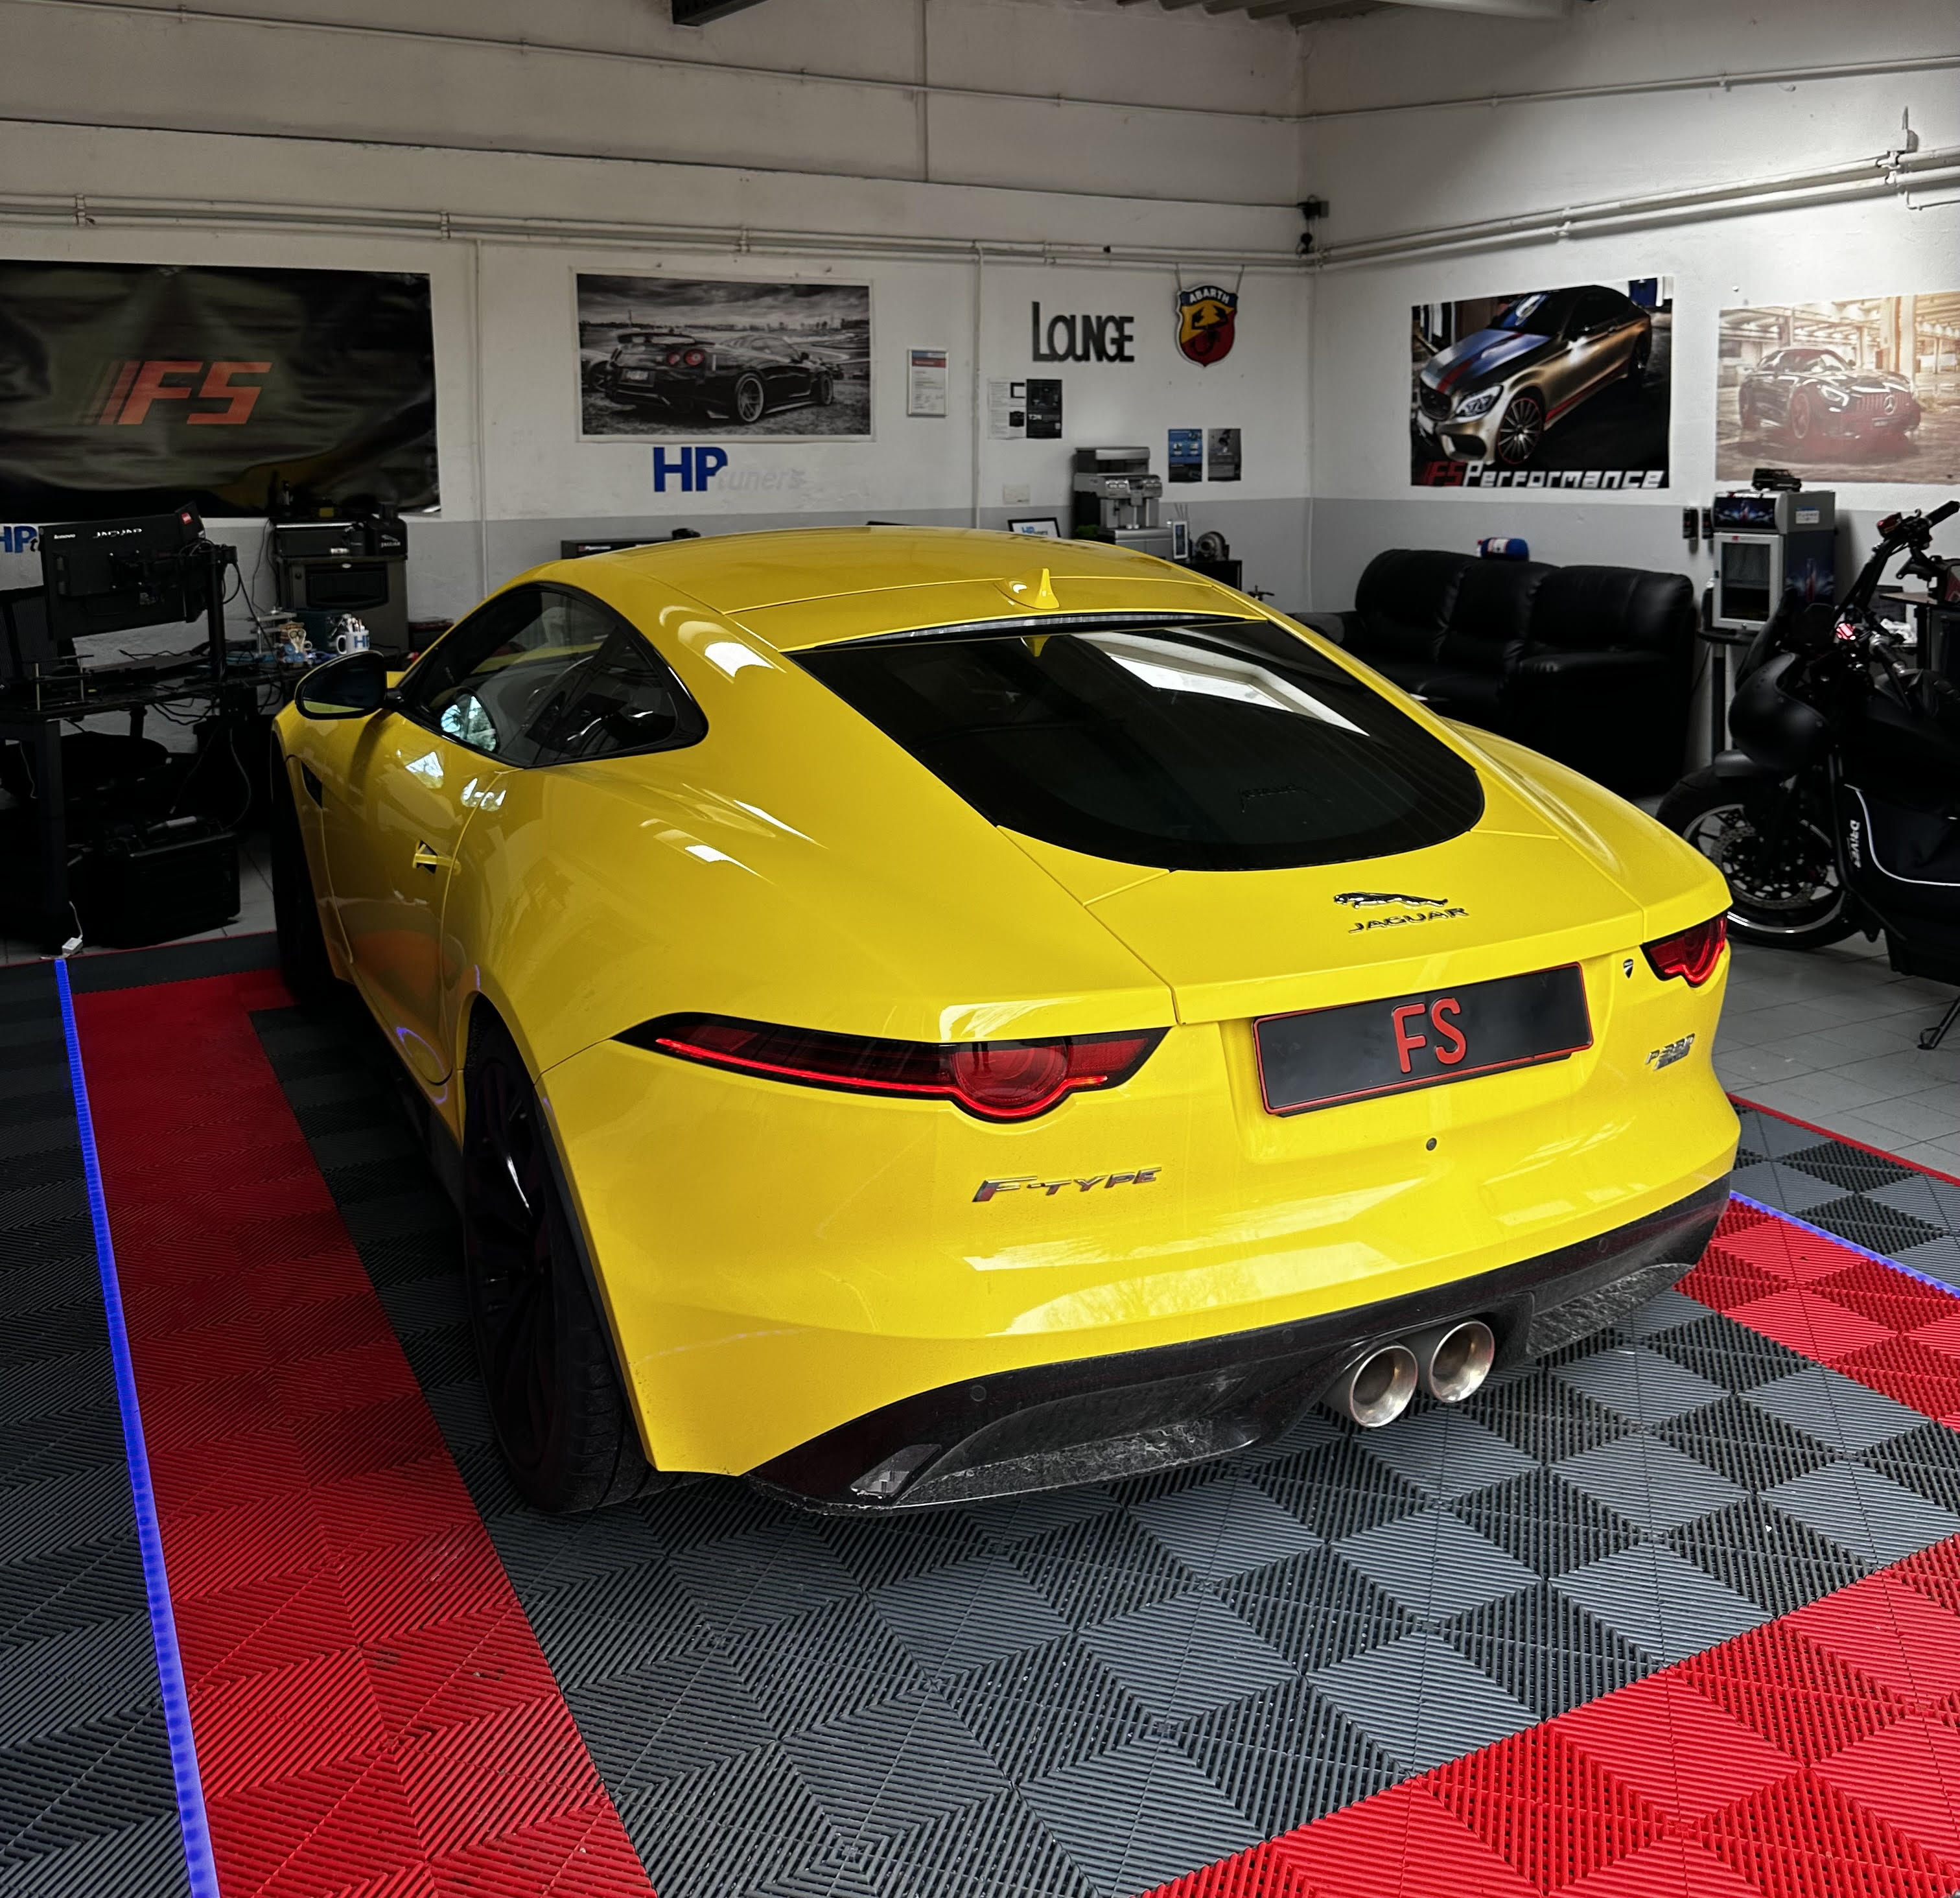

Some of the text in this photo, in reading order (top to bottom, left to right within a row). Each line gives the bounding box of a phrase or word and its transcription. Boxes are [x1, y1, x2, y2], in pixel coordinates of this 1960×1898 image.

[1189, 287, 1230, 304] ABARTH
[1348, 908, 1469, 934] JAGUAR
[1392, 998, 1467, 1074] FS
[972, 1166, 1162, 1203] F-TYPE
